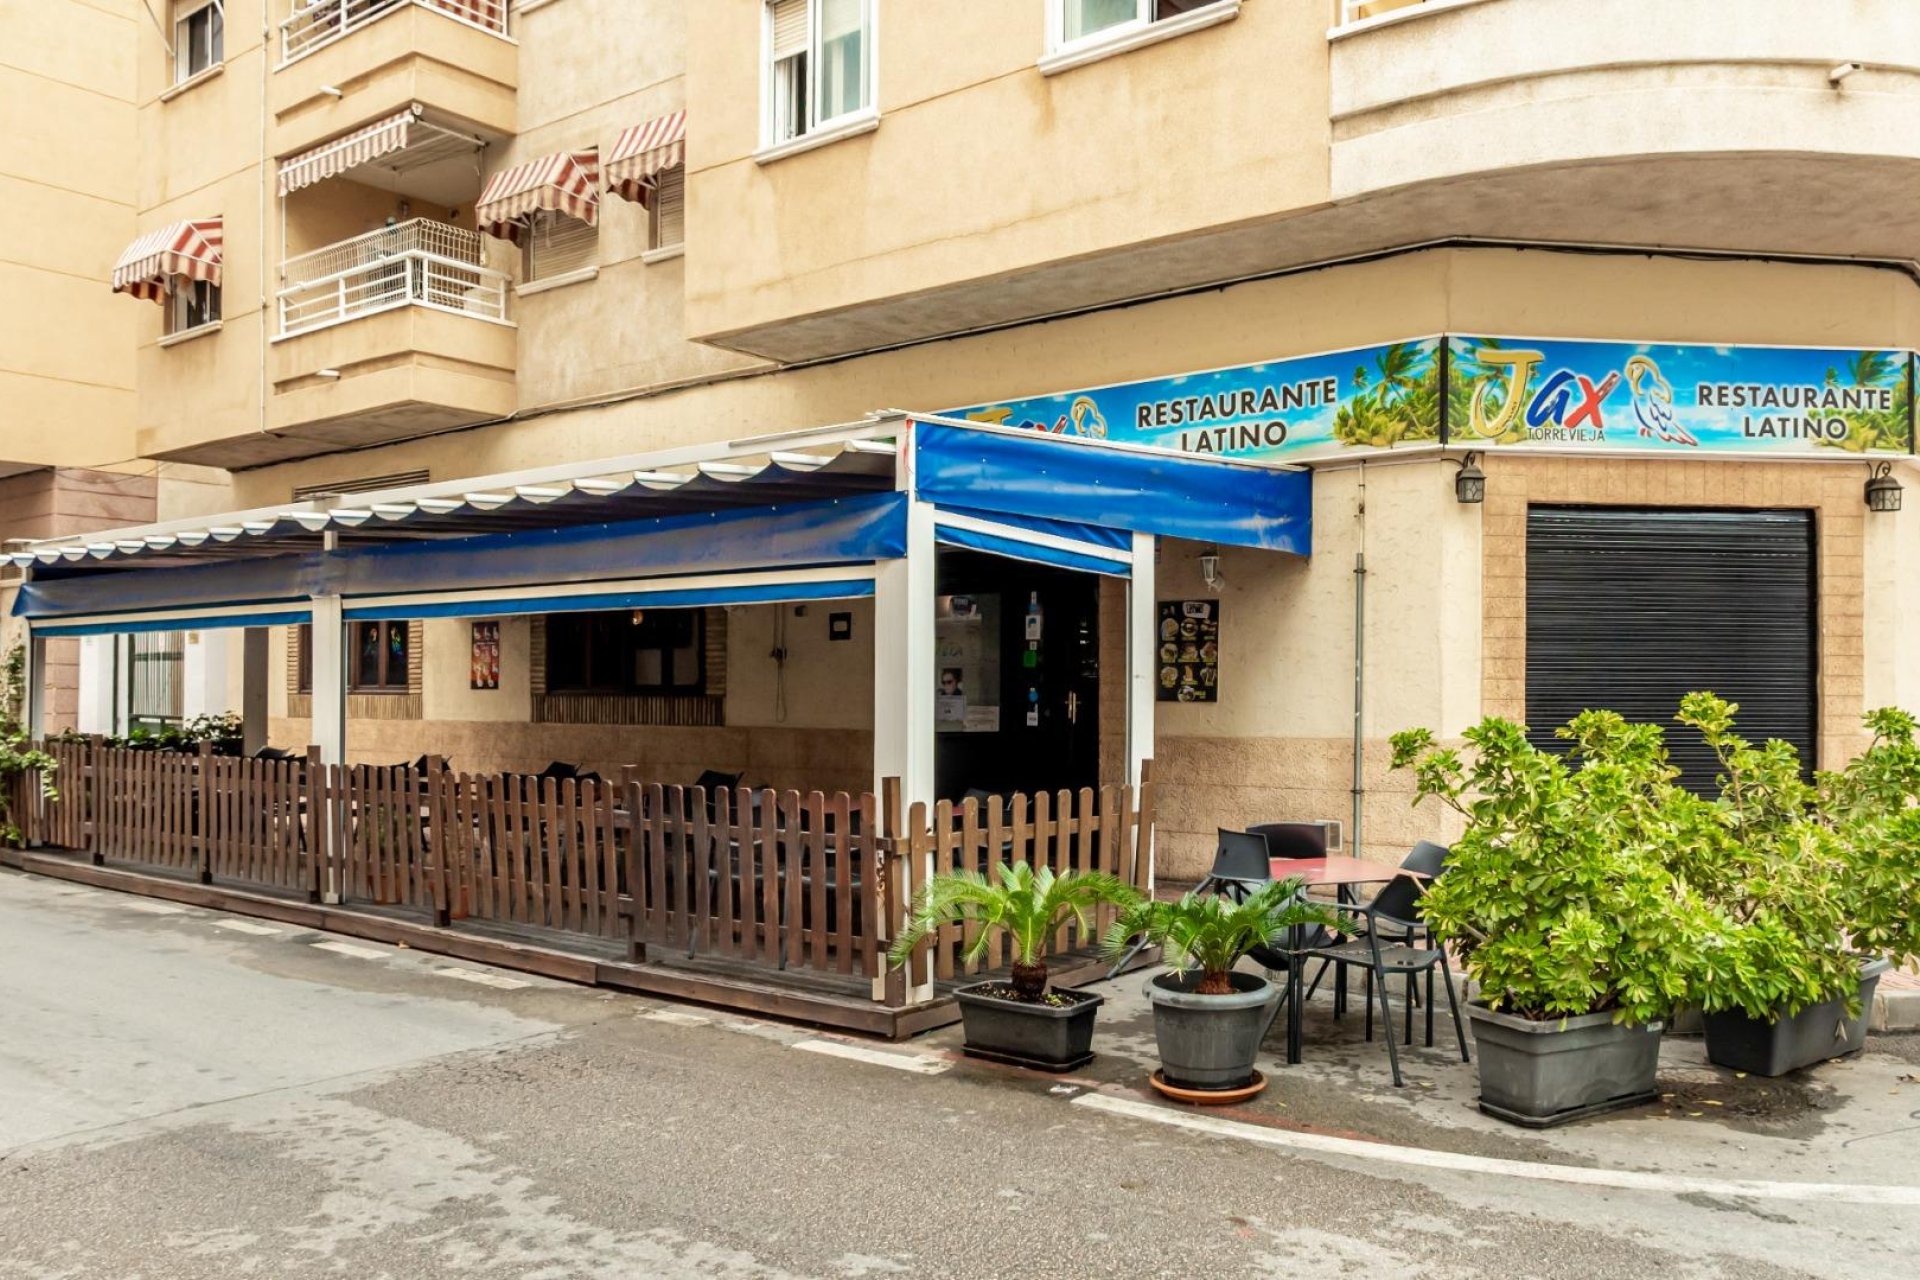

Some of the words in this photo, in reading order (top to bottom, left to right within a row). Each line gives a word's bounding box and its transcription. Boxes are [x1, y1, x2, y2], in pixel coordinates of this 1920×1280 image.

[1138, 379, 1336, 427] RESTAURANTE
[1698, 384, 1891, 409] RESTAURANTE
[1182, 421, 1287, 453] LATINO
[1528, 428, 1605, 441] TORREVIEJA
[1744, 416, 1847, 439] LATINO
